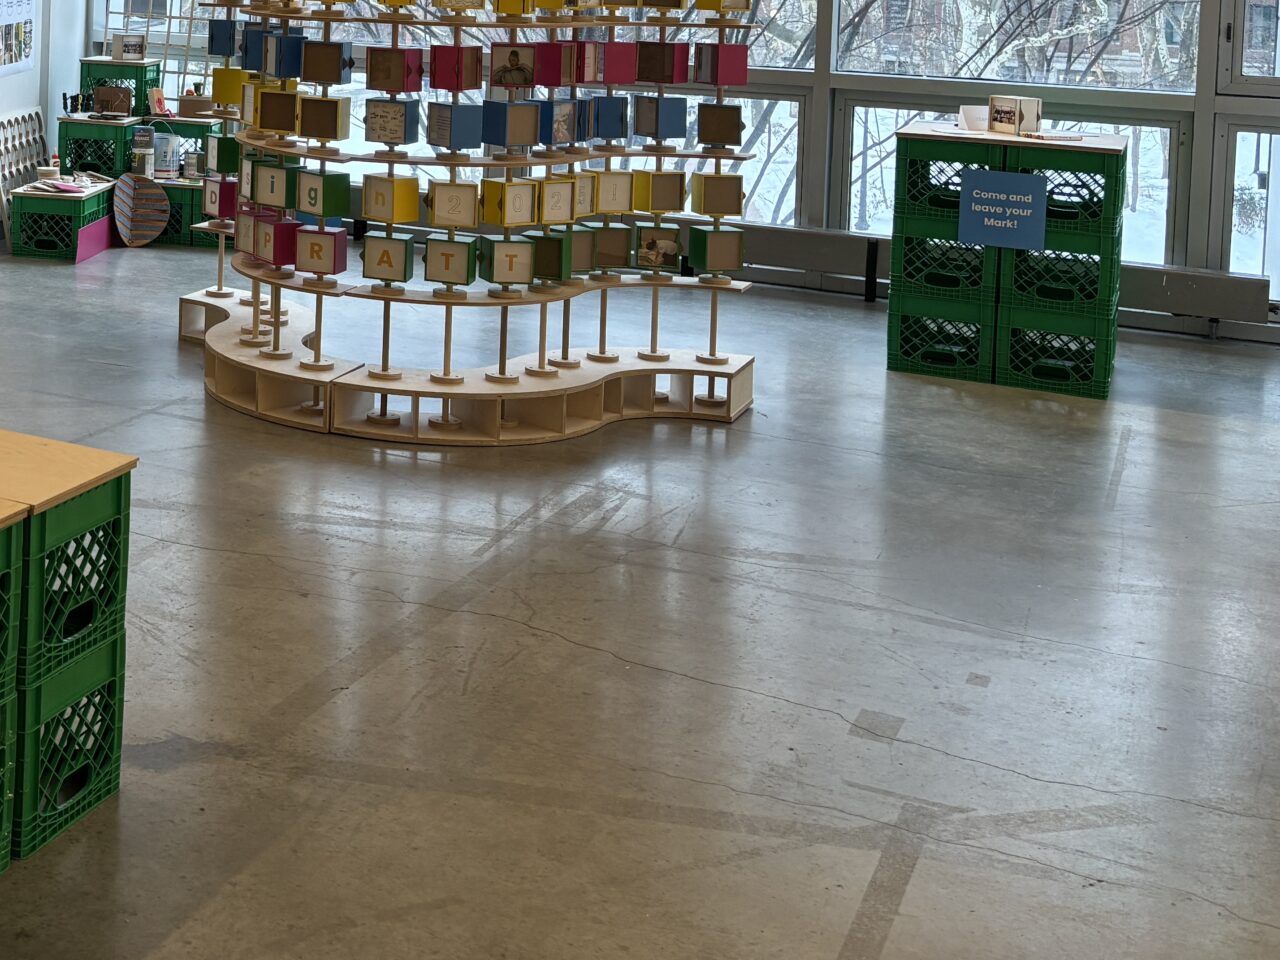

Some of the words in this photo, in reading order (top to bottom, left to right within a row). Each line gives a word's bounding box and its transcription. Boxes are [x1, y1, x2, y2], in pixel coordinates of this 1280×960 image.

[270, 175, 275, 194] i
[210, 190, 217, 205] D
[307, 187, 318, 207] g
[375, 191, 387, 207] n
[447, 194, 461, 214] 2
[551, 192, 562, 211] 2
[972, 189, 1007, 201] Come
[1009, 193, 1032, 203] and
[972, 202, 1004, 214] leave
[1005, 208, 1032, 218] your
[984, 218, 1018, 229] Mark!
[264, 232, 271, 248] P
[309, 242, 323, 260] R
[376, 249, 394, 268] A
[440, 253, 454, 271] T
[505, 254, 518, 271] T
